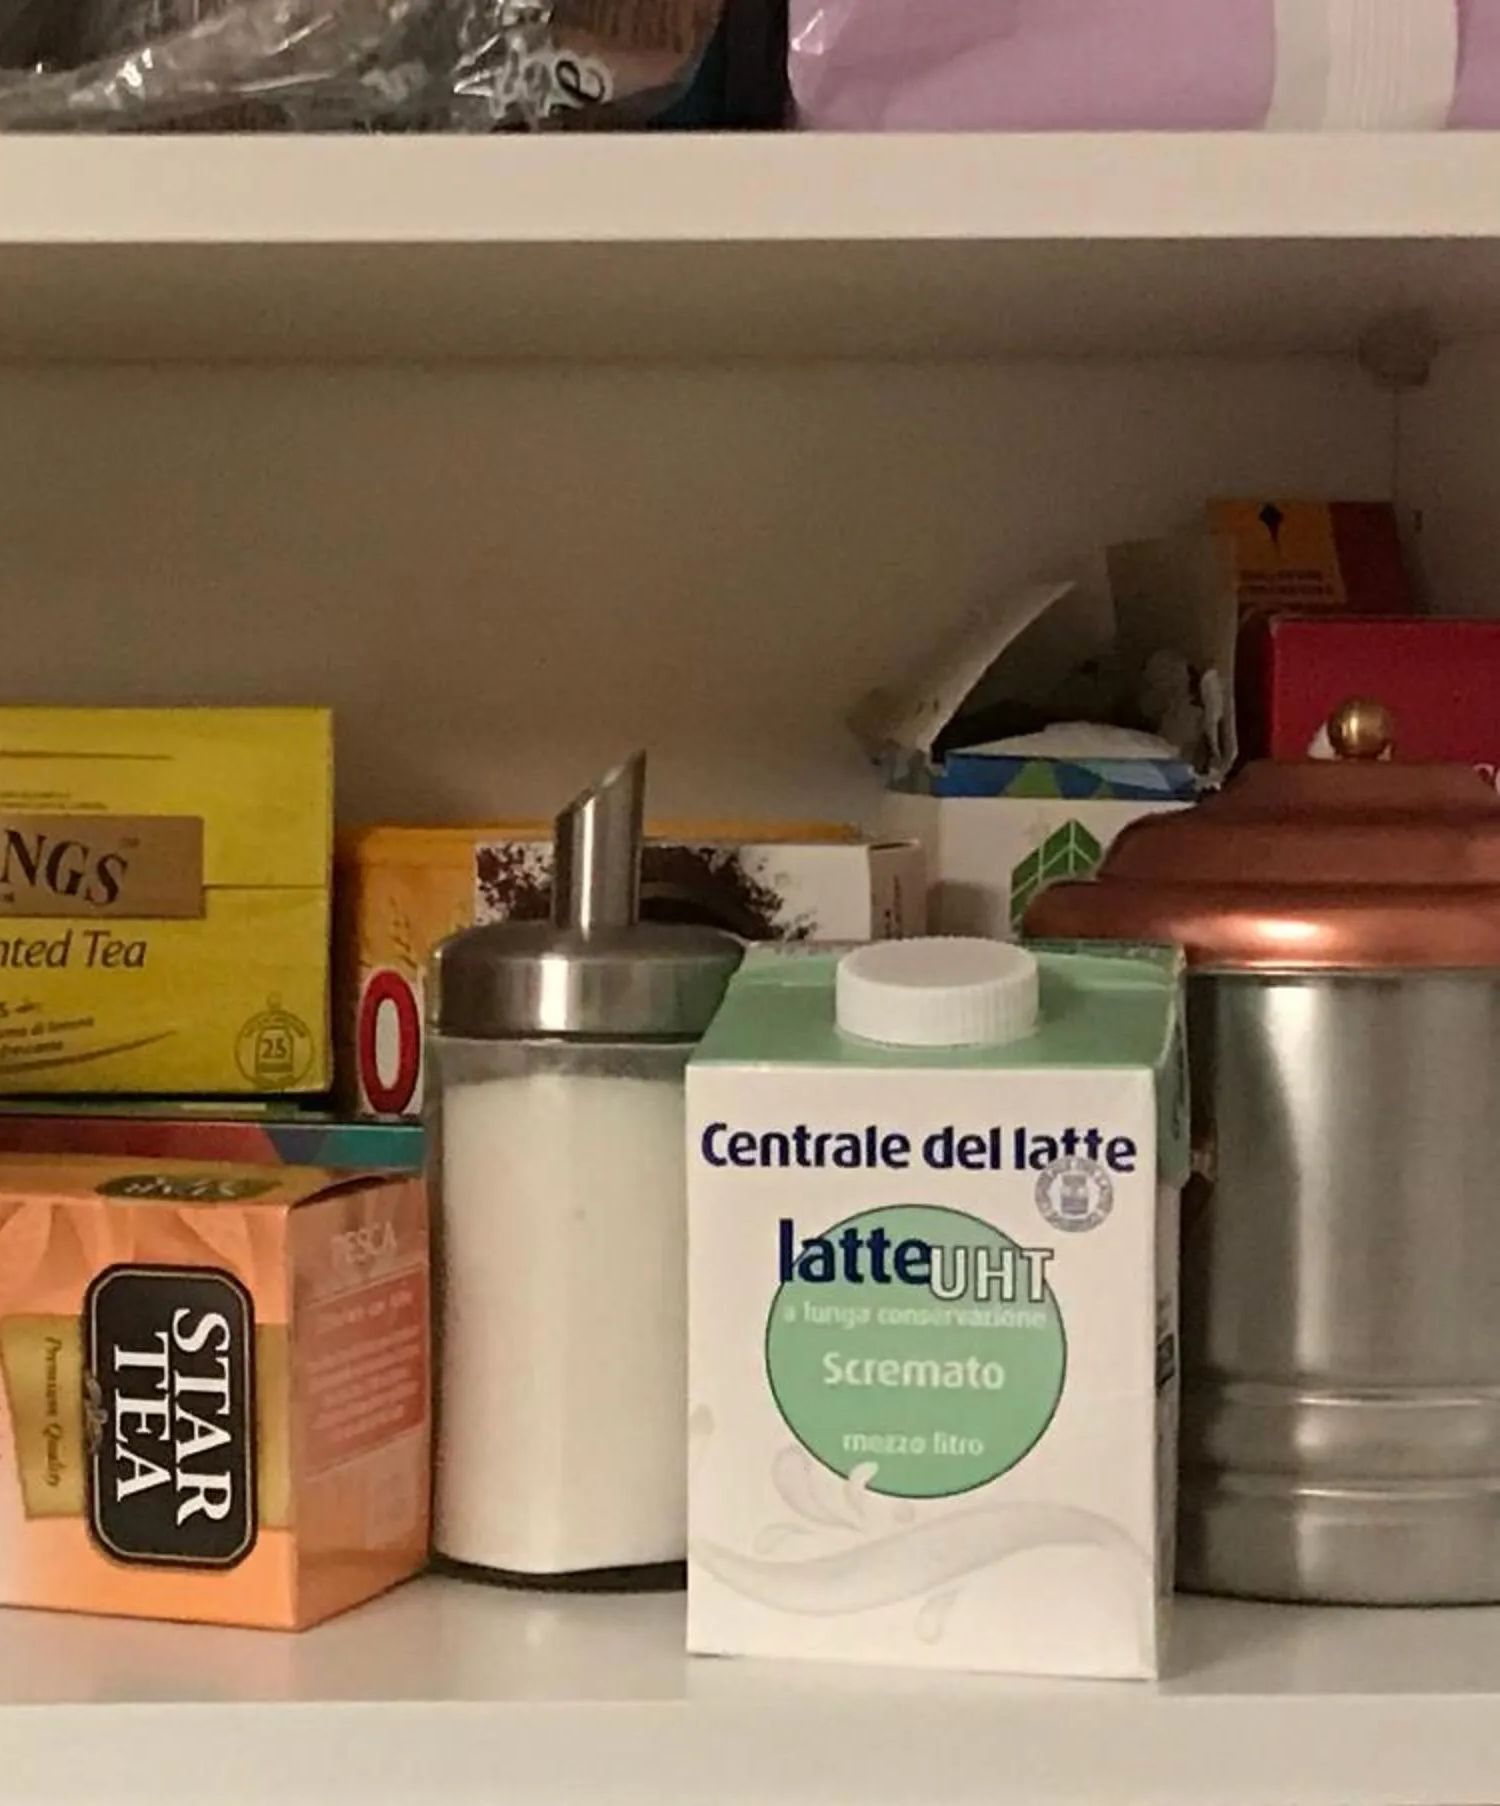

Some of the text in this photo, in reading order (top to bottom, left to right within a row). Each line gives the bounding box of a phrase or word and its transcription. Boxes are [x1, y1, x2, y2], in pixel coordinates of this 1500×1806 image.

[82, 930, 148, 969] Tea
[261, 1037, 289, 1059] 25
[700, 1122, 1138, 1174] Centrale del latte
[779, 1219, 1055, 1303] latte UHT
[783, 1300, 1048, 1331] a lunga conservazione
[821, 1350, 1006, 1392] Scremato
[39, 1335, 67, 1488] Premium Quality
[112, 1329, 172, 1503] TEA
[172, 1305, 234, 1527] STAR
[842, 1431, 986, 1458] mezzo litro
